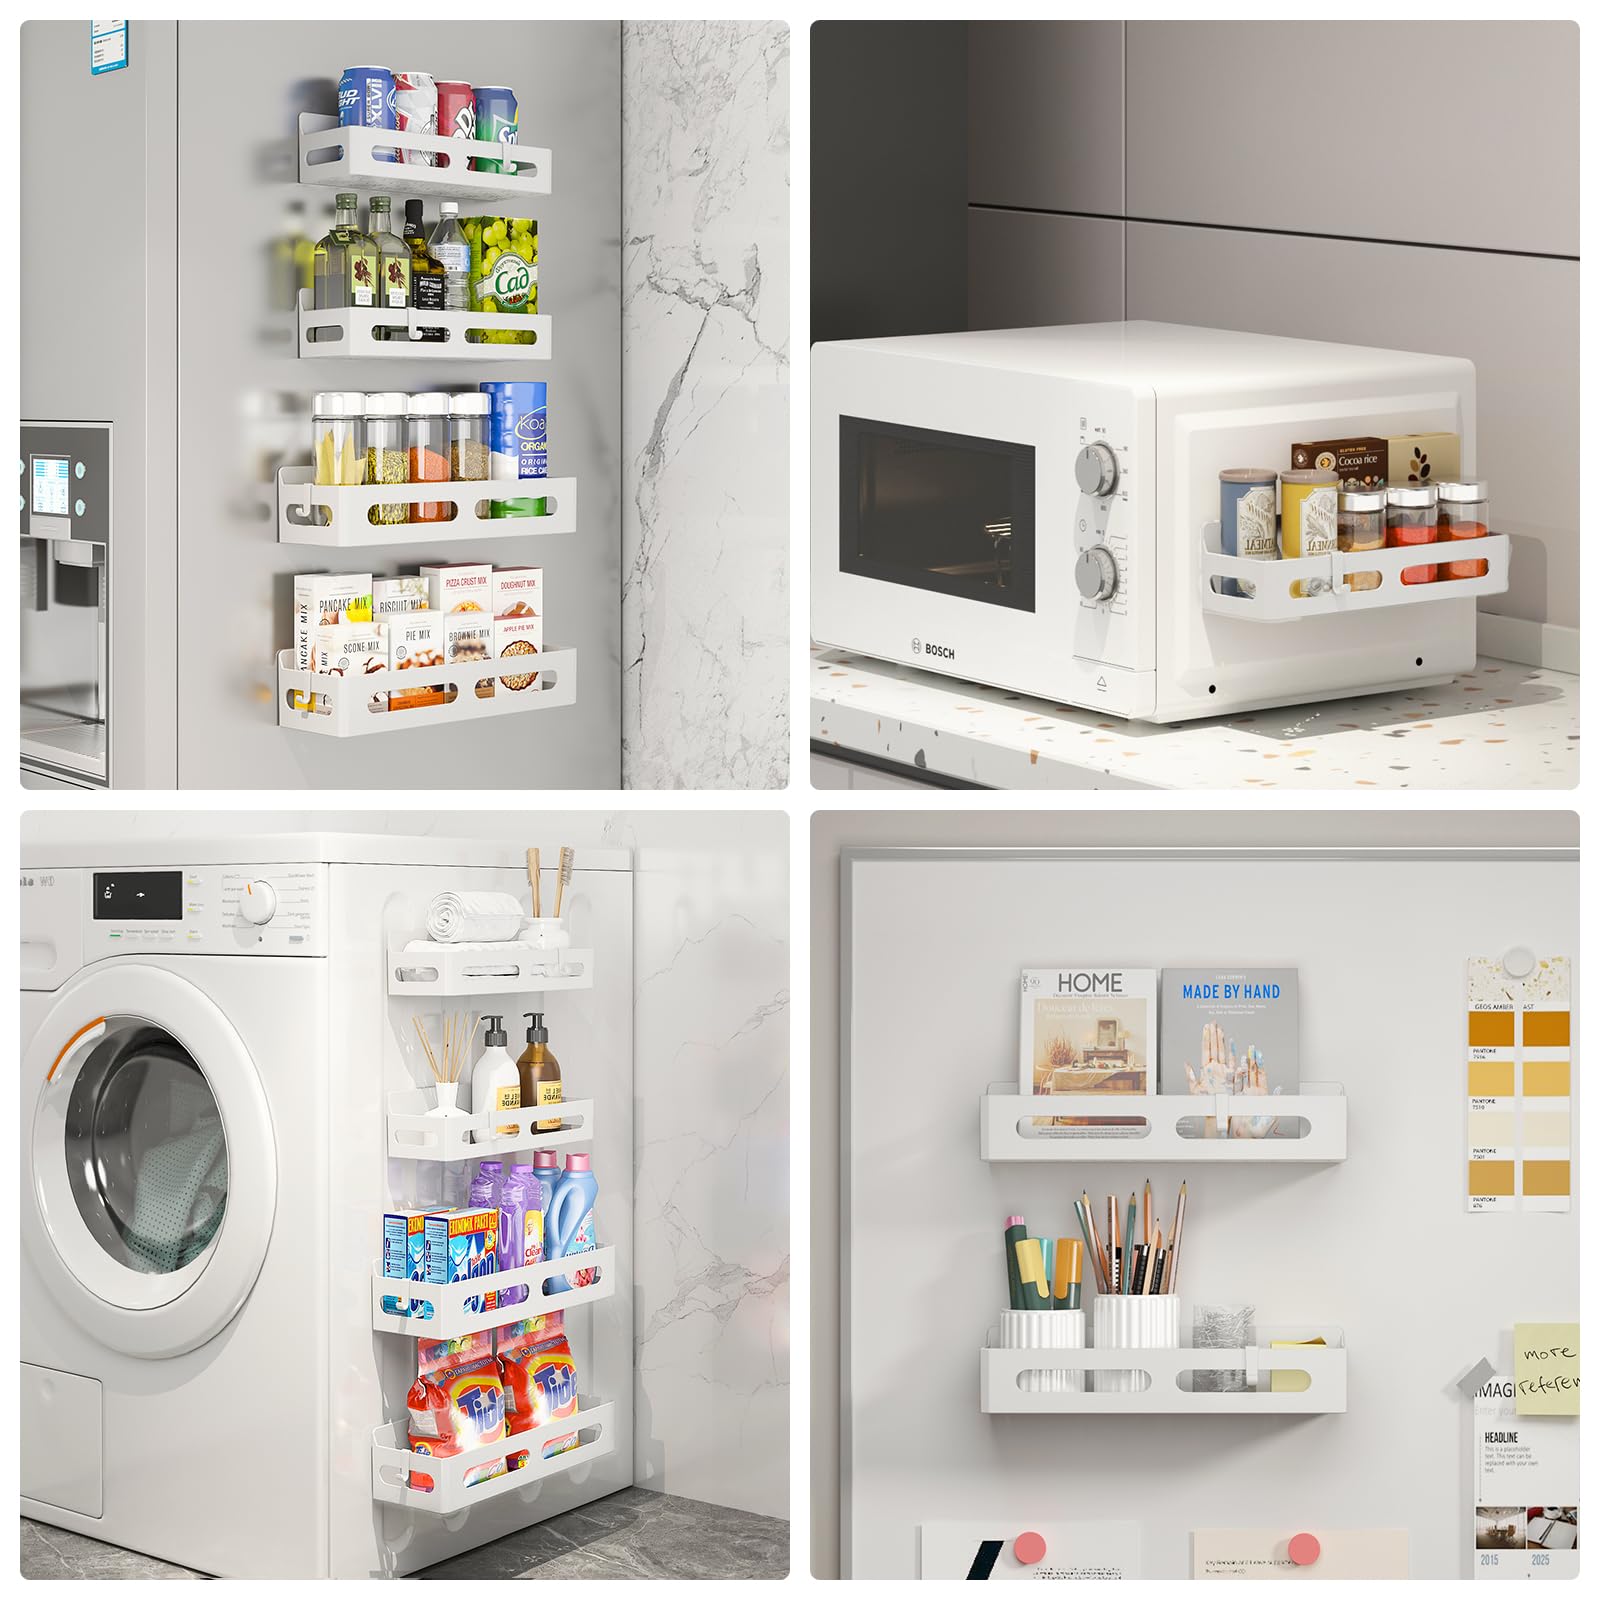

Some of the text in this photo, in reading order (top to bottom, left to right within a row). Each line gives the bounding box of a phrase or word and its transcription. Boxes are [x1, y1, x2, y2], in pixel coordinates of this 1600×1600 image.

[1339, 454, 1378, 466] Cocoa rice
[446, 576, 487, 588] PIZZA CRUST MIX
[501, 580, 536, 590] DOUGHNUT MIX
[319, 597, 368, 613] PANCAKE MIX
[380, 598, 422, 613] BISCUIT MIX
[300, 604, 308, 624] MIX
[406, 629, 431, 641] PIE MIX
[449, 629, 490, 641] BROWNIE MIX
[503, 625, 517, 633] APPLE
[344, 641, 380, 654] SCONE MIX
[926, 643, 954, 660] BOSCH
[1058, 973, 1122, 992] HOME
[1183, 984, 1281, 999] MADE BY HAND
[1524, 1347, 1577, 1360] more
[1485, 1432, 1518, 1443] HEADLINE
[1481, 1554, 1499, 1566] 2015
[1532, 1554, 1550, 1566] 2025
